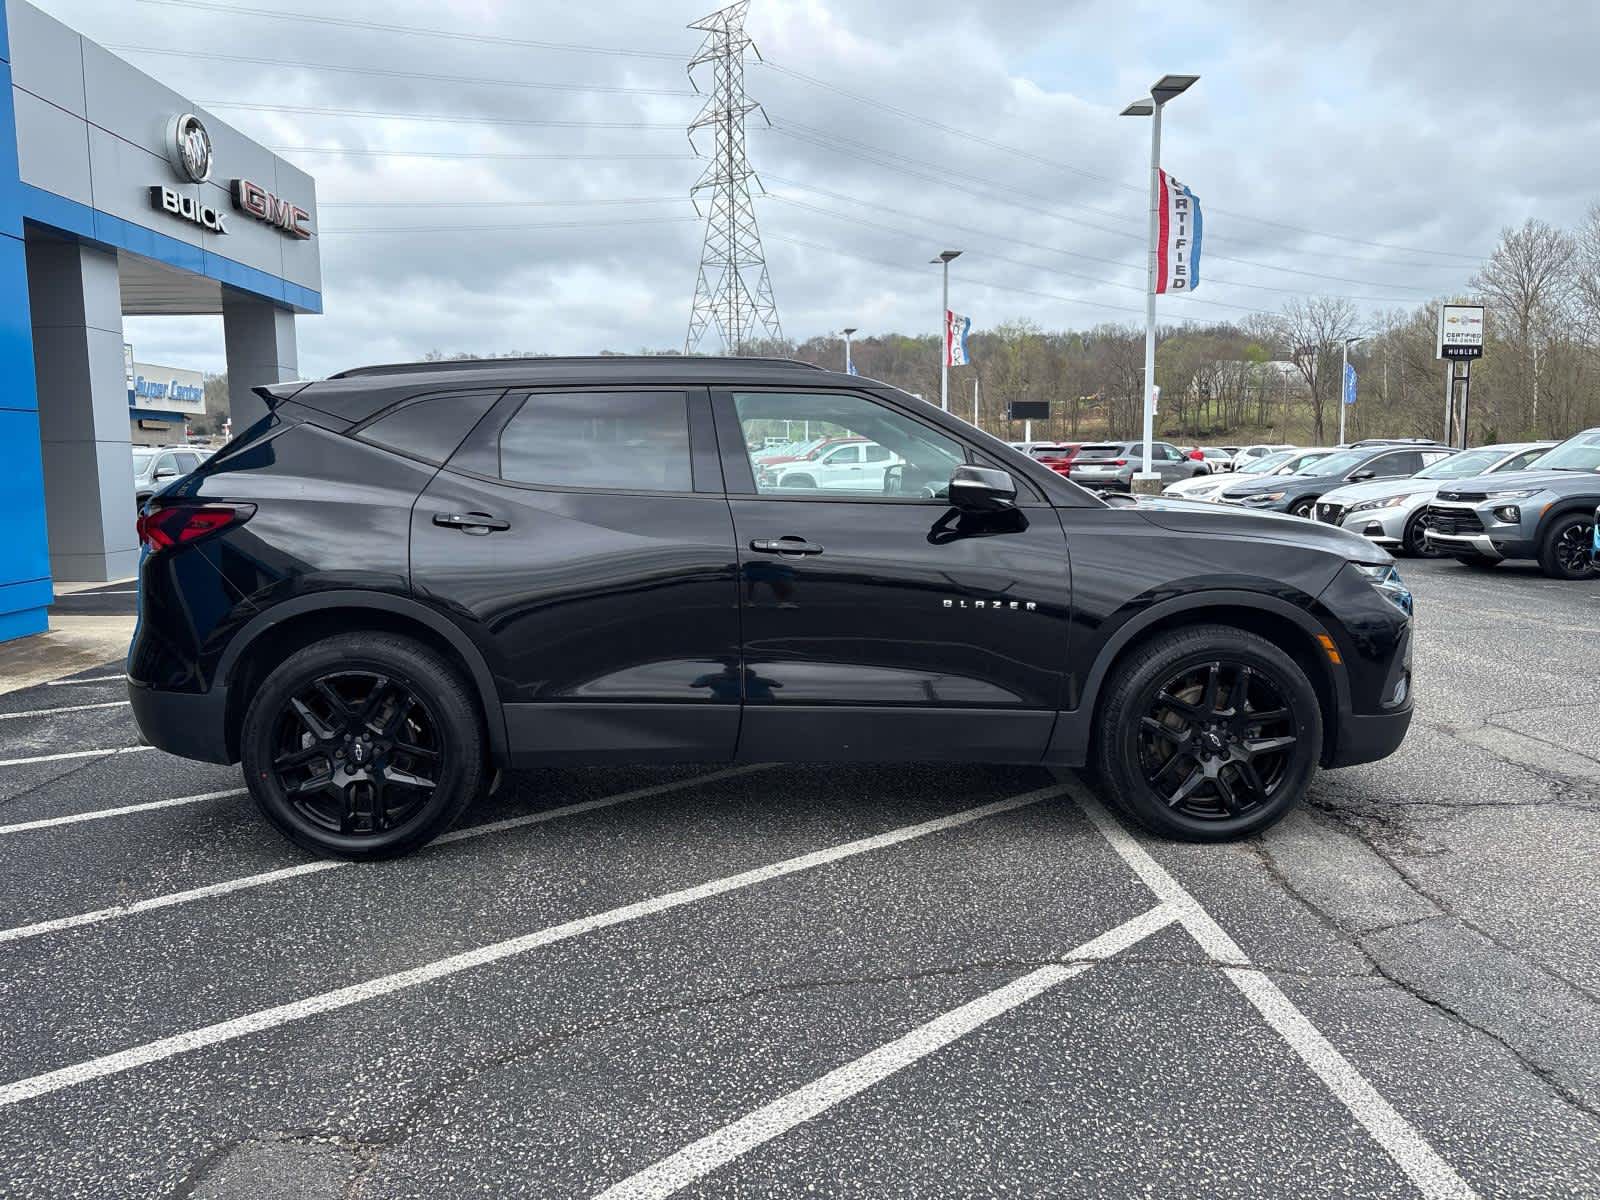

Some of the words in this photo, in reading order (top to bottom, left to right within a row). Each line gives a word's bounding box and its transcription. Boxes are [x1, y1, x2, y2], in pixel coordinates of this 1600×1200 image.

[159, 186, 229, 235] BUICK
[235, 179, 310, 240] GMC
[136, 375, 167, 401] Super
[168, 379, 203, 402] Center
[943, 599, 1036, 610] BLAZER
